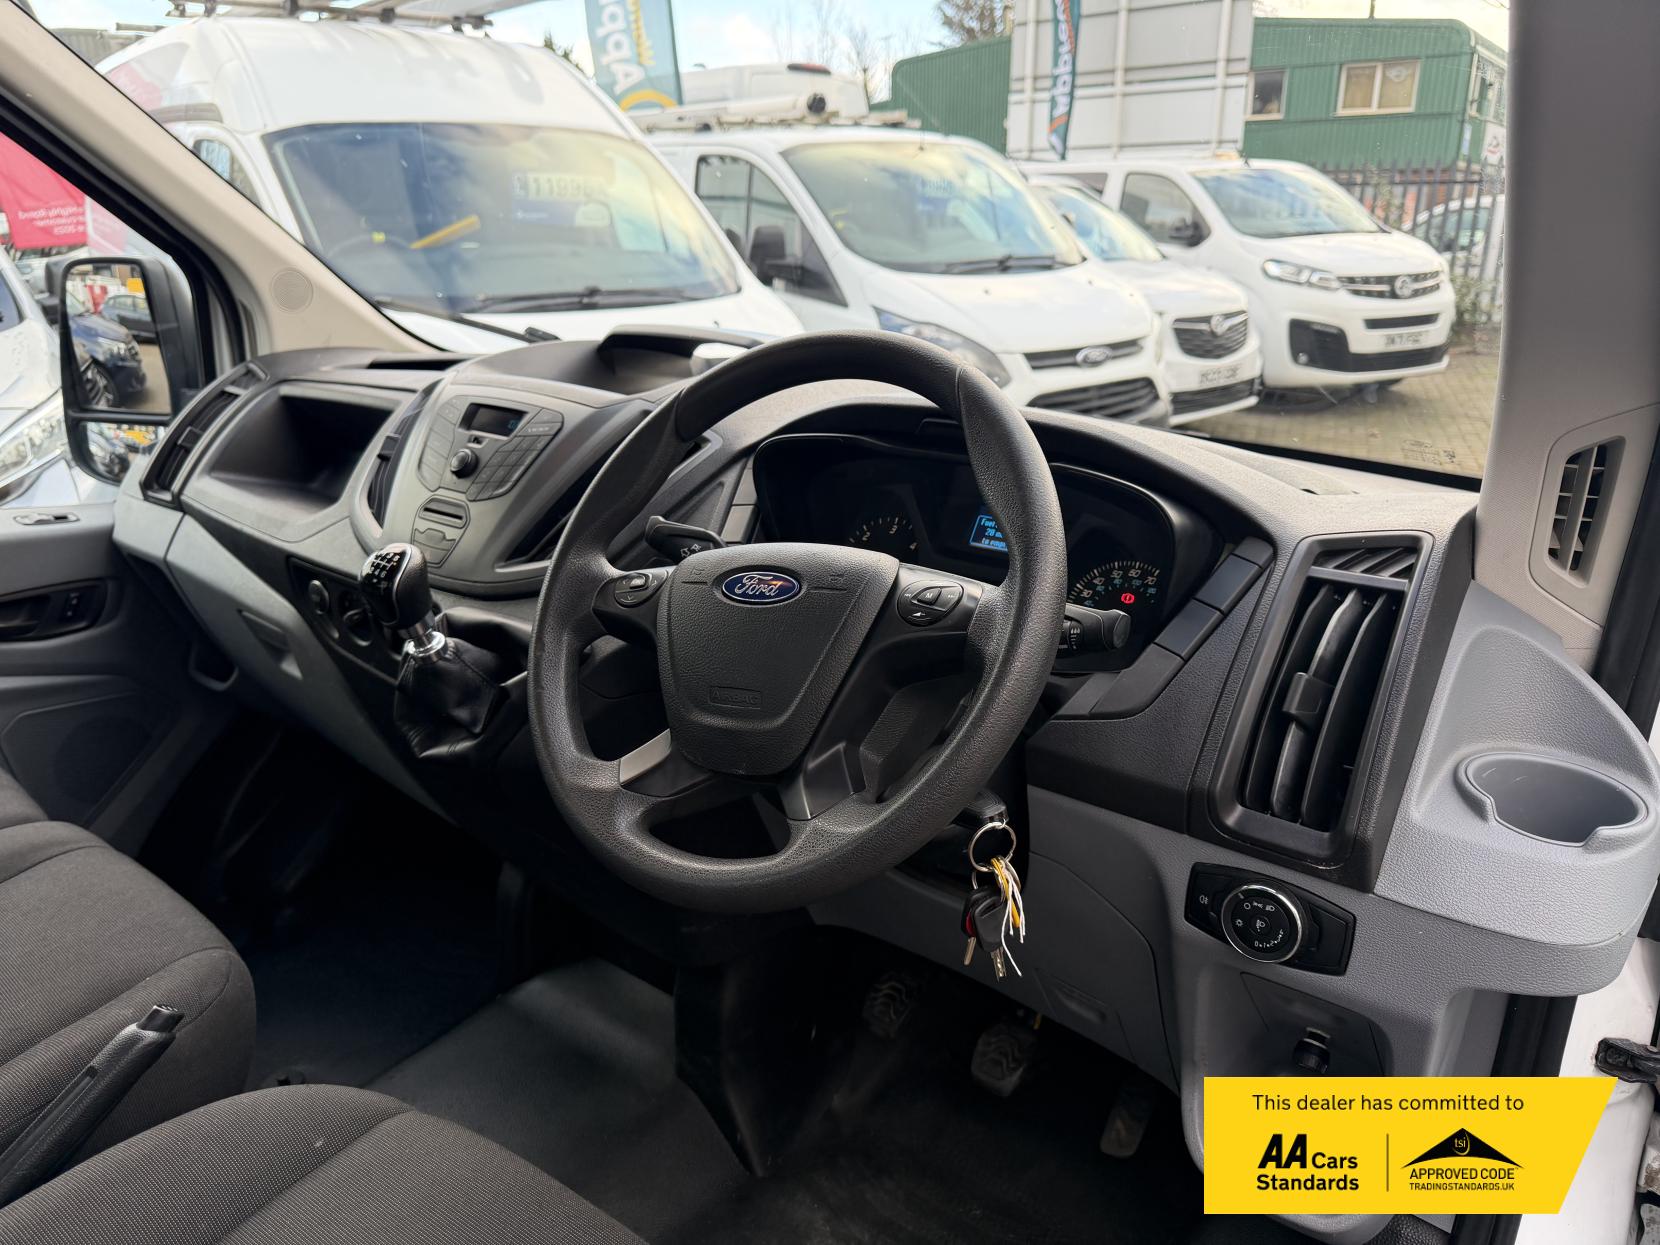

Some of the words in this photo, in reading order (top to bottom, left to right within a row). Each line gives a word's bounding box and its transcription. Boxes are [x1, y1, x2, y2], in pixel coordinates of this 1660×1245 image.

[889, 525, 898, 534] 3
[1110, 570, 1123, 578] 50
[1128, 569, 1141, 578] 60
[1144, 576, 1157, 585] 70
[734, 575, 783, 597] Ford
